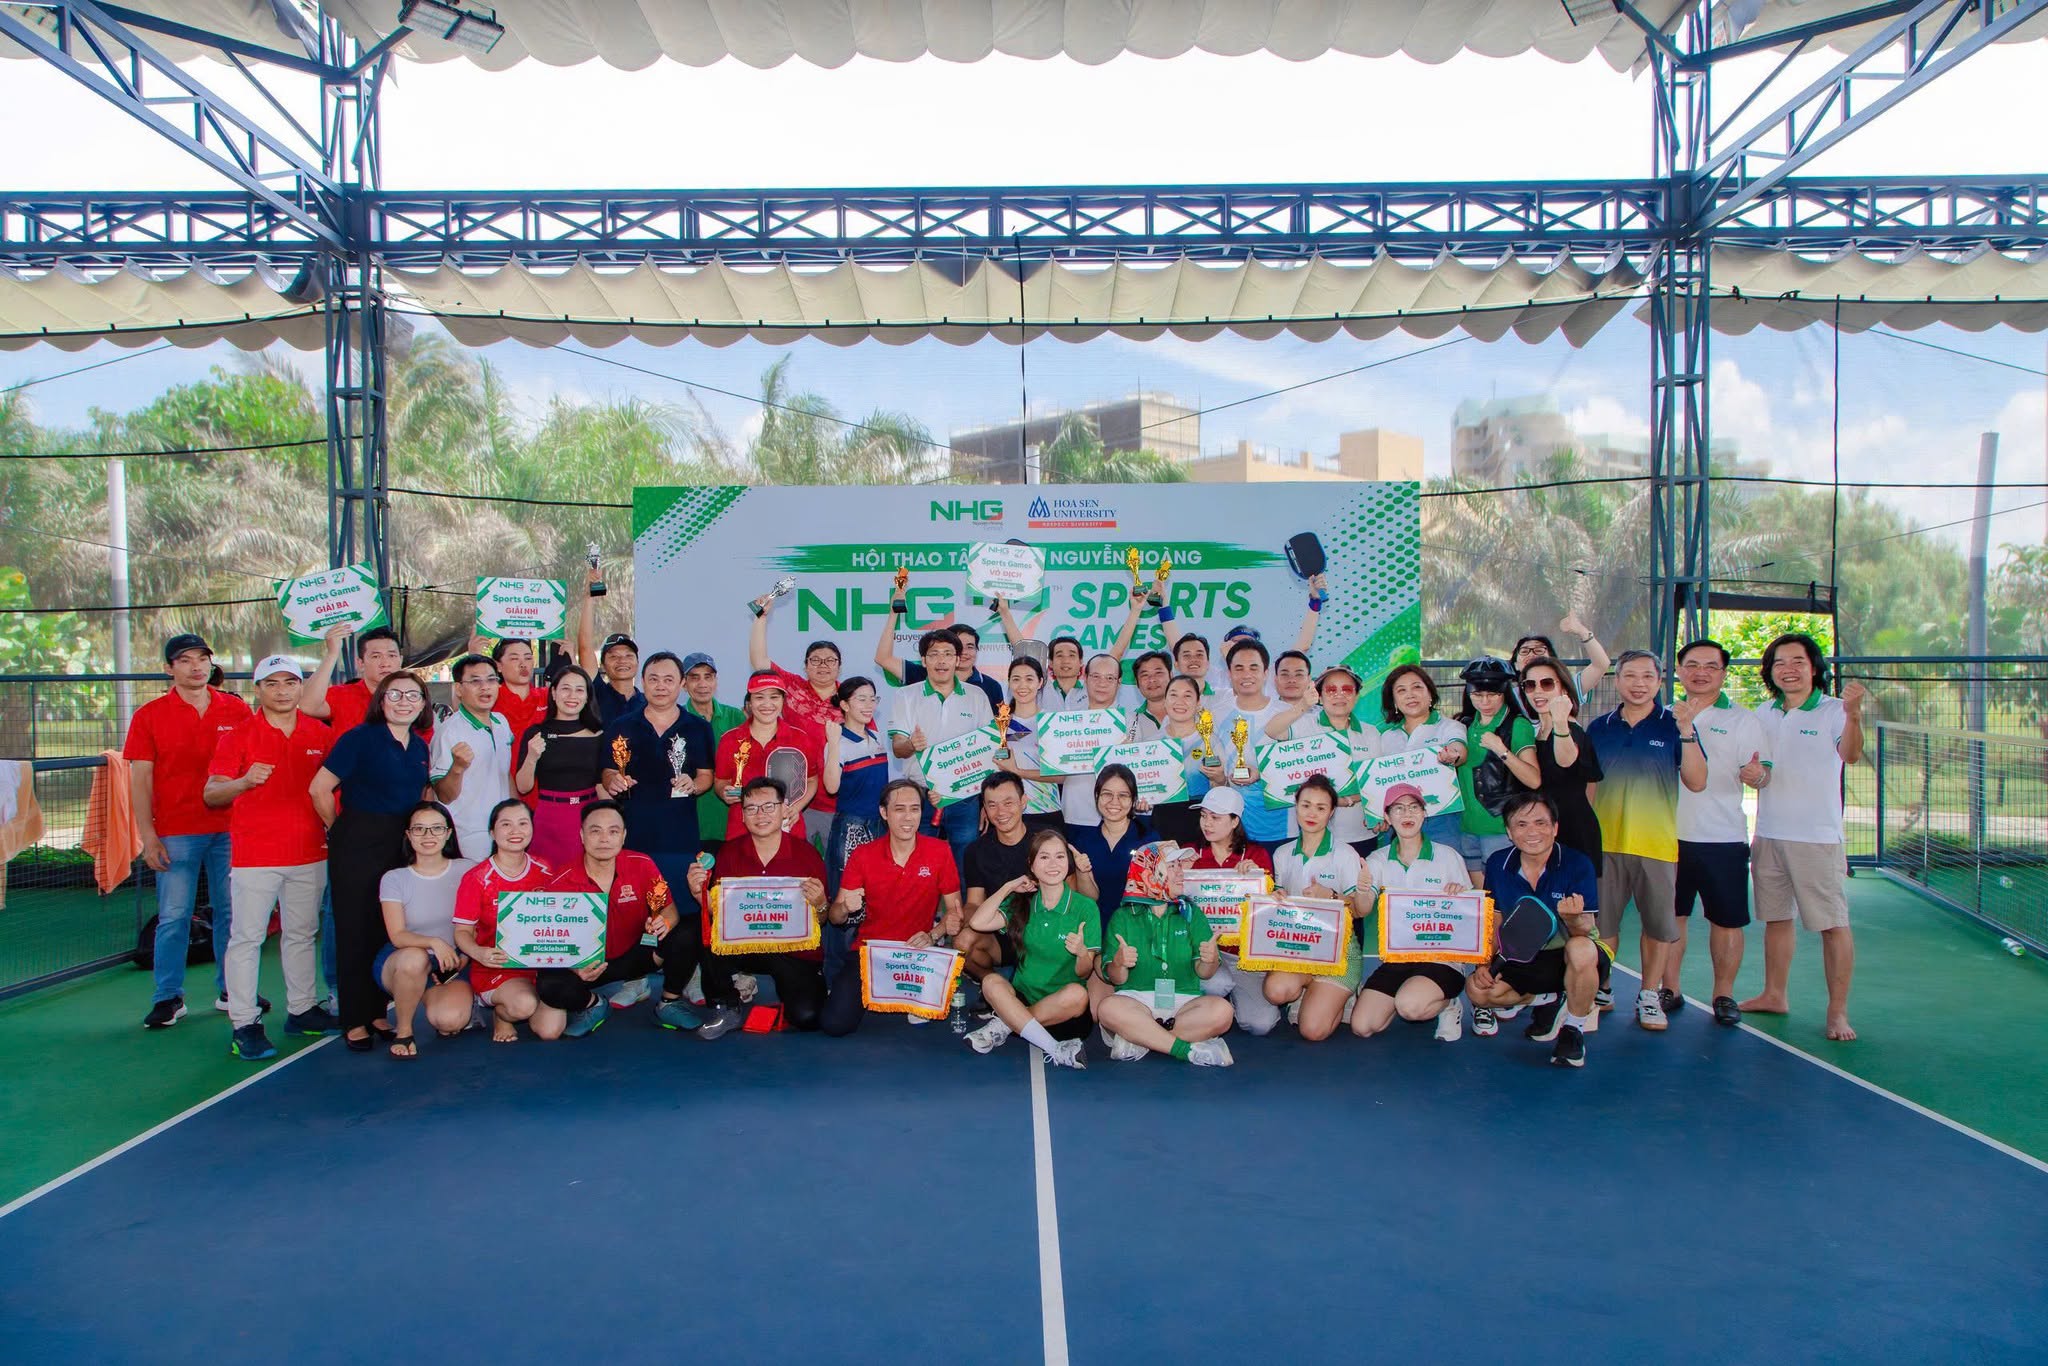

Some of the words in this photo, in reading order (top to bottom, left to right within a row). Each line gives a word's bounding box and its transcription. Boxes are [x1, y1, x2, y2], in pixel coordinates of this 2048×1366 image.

[1054, 500, 1076, 508] HOA
[1078, 500, 1099, 508] SEN
[930, 501, 1003, 521] NHG
[1054, 509, 1117, 518] UNIVERSITY
[988, 546, 1009, 554] NHG
[1050, 543, 1126, 565] NGUYỄN
[852, 548, 886, 571] HỘI
[891, 551, 943, 567] THAO
[948, 548, 968, 571] TẬ
[982, 558, 1007, 567] Sports
[1008, 561, 1032, 569] Games
[299, 576, 327, 589] NHG
[332, 572, 346, 584] 27
[500, 581, 524, 589] NHG
[530, 583, 542, 593] 27
[296, 591, 328, 605] Sports
[329, 585, 361, 597] Games
[493, 594, 521, 604] Sports
[523, 596, 551, 604] Games
[315, 602, 335, 614] GIẢI
[336, 600, 350, 609] BA
[505, 606, 523, 614] GIẢI
[798, 587, 955, 632] NHG
[1089, 713, 1101, 723] 27
[1053, 729, 1082, 738] Sports
[1083, 727, 1112, 735] Games
[937, 740, 961, 754] NHG
[965, 735, 977, 746] 27
[1067, 739, 1084, 748] GIẢI
[1278, 741, 1305, 753] NHG
[1309, 739, 1323, 750] 27
[1115, 747, 1139, 756] NHG
[1145, 744, 1157, 755] 27
[937, 755, 964, 769] Sports
[964, 745, 992, 759] Games
[1274, 758, 1305, 770] Sports
[1306, 752, 1337, 764] Games
[1378, 756, 1405, 769] NHG
[1411, 752, 1425, 765] 27
[954, 764, 971, 776] GIẢI
[971, 760, 983, 769] BA
[1141, 759, 1169, 768] Games
[1288, 771, 1302, 781] VÔ
[1375, 774, 1406, 786] Sports
[1407, 767, 1439, 779] Games
[526, 897, 556, 906] NHG
[563, 897, 578, 910] 27
[739, 902, 764, 911] Sports
[765, 902, 793, 910] Games
[1202, 904, 1216, 915] IẢI
[1413, 900, 1436, 908] NHG
[1441, 900, 1453, 910] 27
[516, 913, 552, 924] Sports
[554, 913, 589, 923] Games
[743, 911, 767, 922] GIẢI
[769, 910, 789, 922] NHÌ
[1406, 912, 1431, 920] Sports
[1433, 912, 1462, 920] Games
[1268, 919, 1293, 928] Sports
[1295, 922, 1322, 931] Games
[1412, 920, 1436, 932] GIẢI
[1438, 923, 1454, 932] BA
[533, 926, 555, 937] GIẢI
[556, 929, 571, 937] BA
[1267, 929, 1290, 940] GIẢI
[1292, 931, 1322, 944] NHẤT
[533, 945, 569, 953] Pickleball
[892, 952, 912, 960] NHG
[917, 953, 928, 961] 27
[885, 962, 909, 971] Sports
[910, 963, 934, 973] Games
[893, 970, 914, 981] GIẢI
[915, 975, 926, 984] BA
